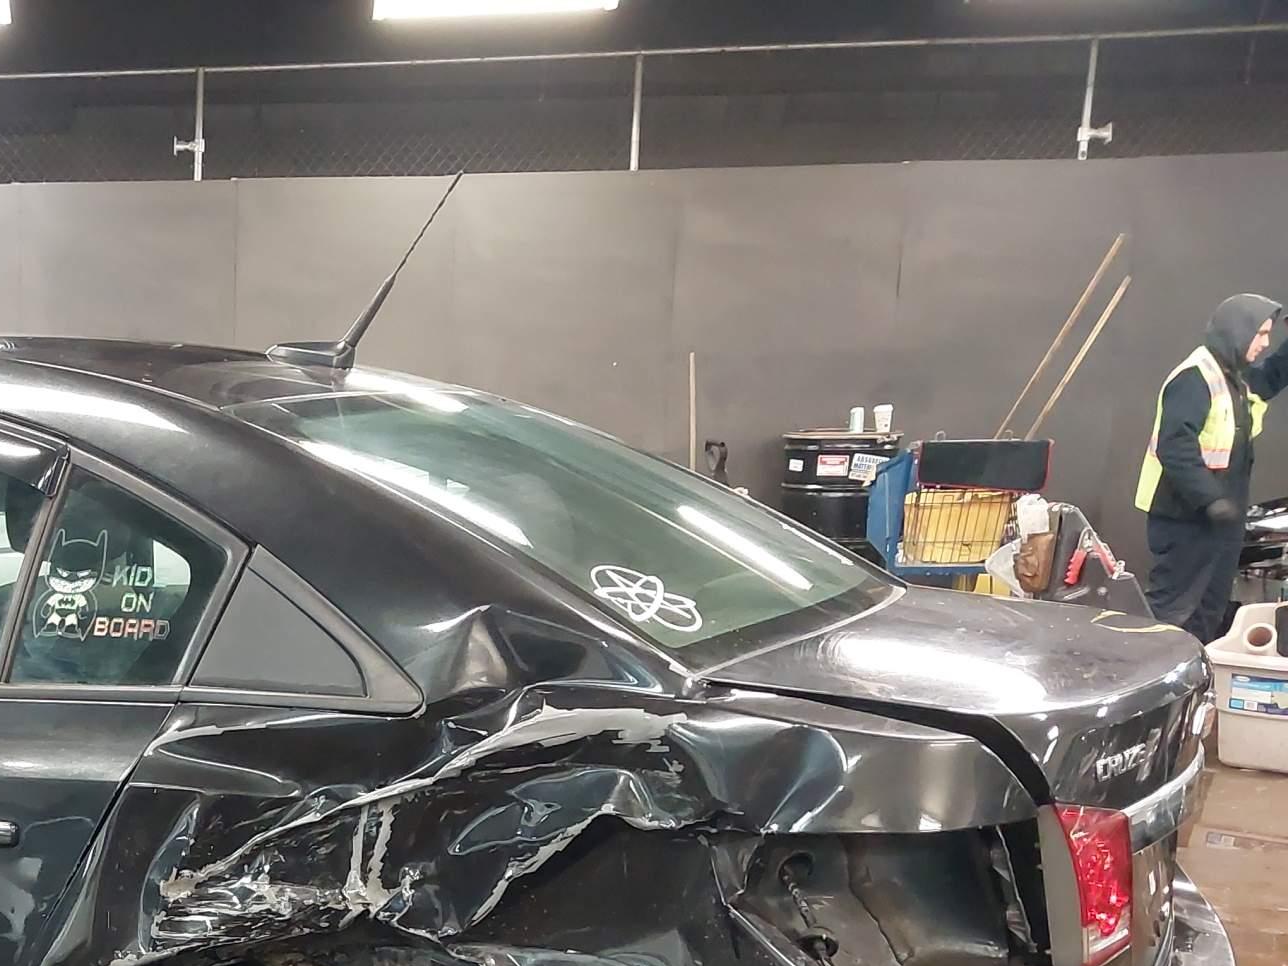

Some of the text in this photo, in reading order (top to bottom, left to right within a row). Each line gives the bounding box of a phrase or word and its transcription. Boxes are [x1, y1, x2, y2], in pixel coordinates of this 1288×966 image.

[121, 591, 155, 613] ON
[93, 616, 170, 641] BOARD
[1096, 743, 1147, 782] CRUZE
